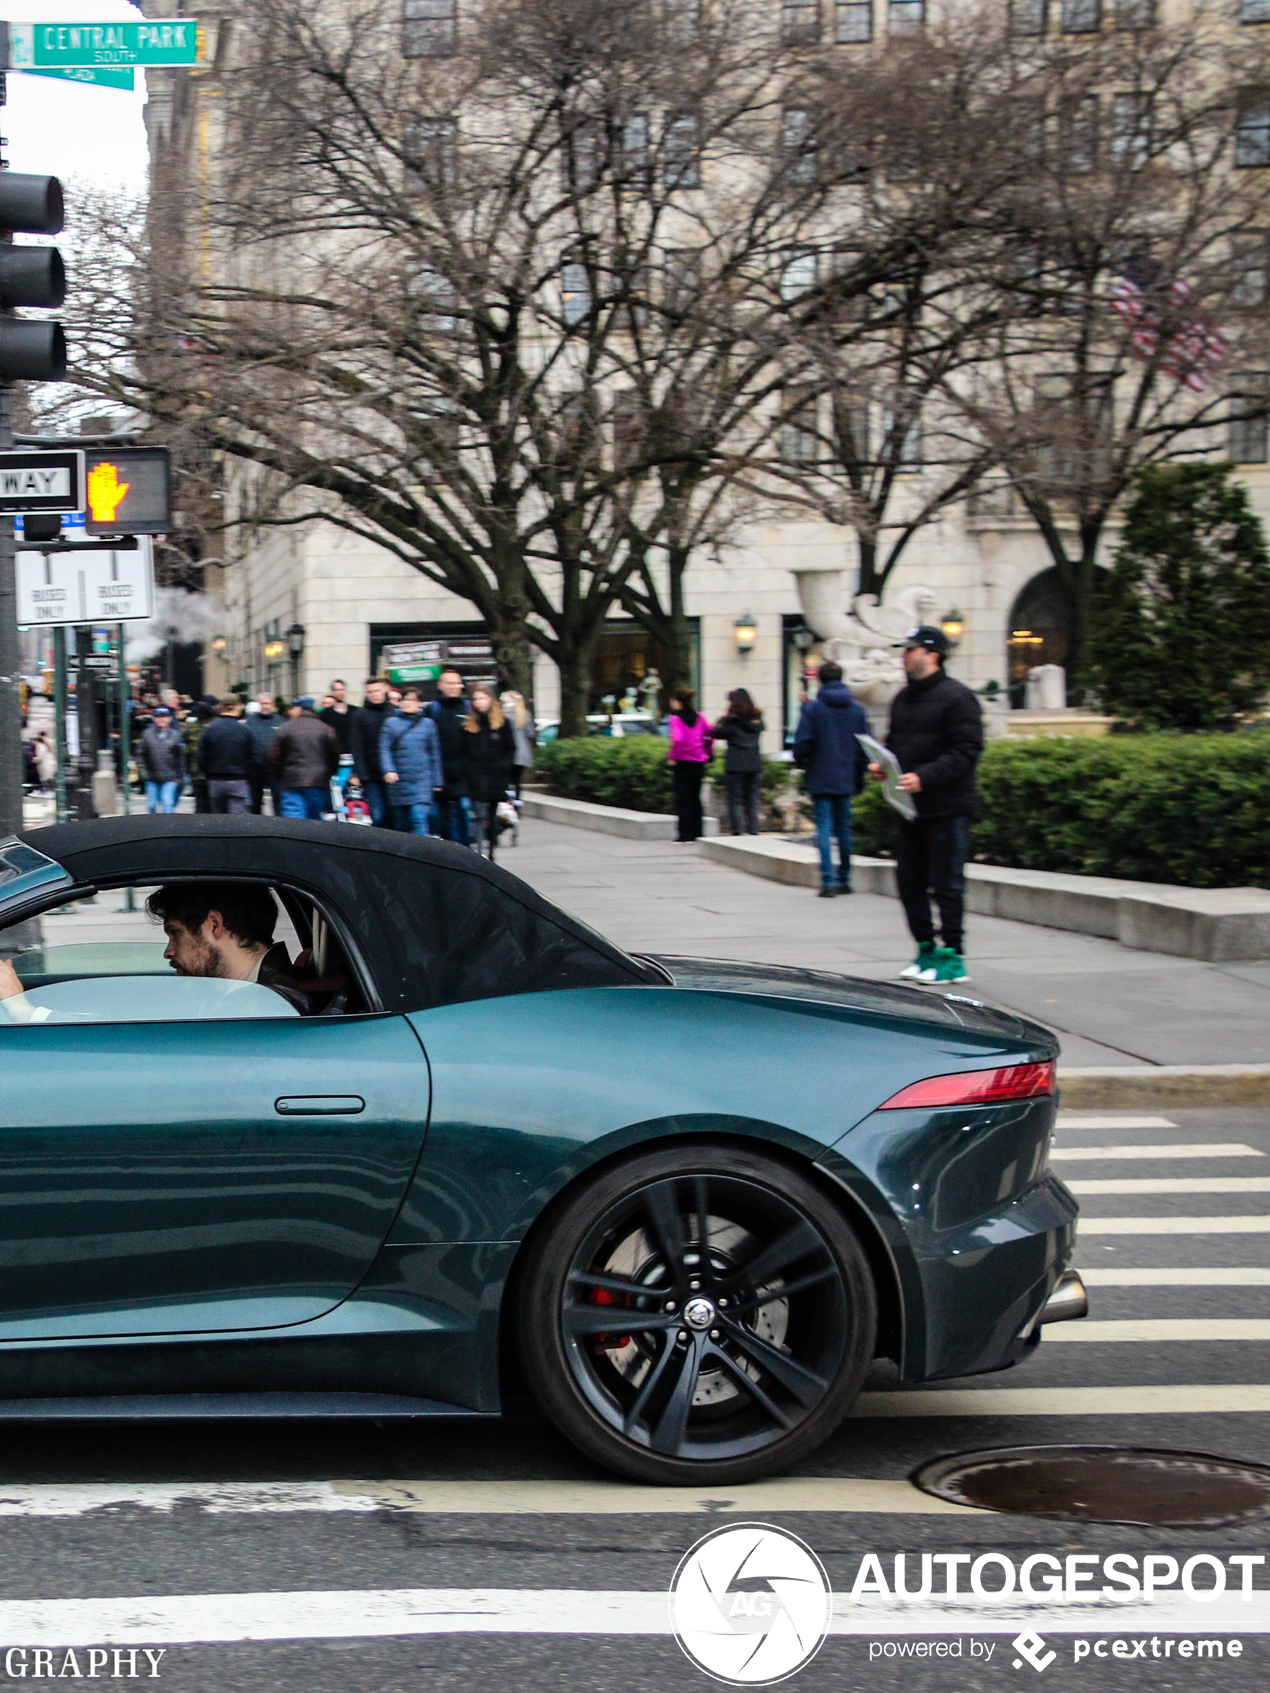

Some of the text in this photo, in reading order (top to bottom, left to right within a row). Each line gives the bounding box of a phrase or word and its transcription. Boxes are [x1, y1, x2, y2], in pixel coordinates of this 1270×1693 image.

[43, 26, 129, 50] CENTRAL
[137, 25, 187, 49] PARK
[94, 50, 138, 63] SOUTH
[0, 471, 59, 495] WAY
